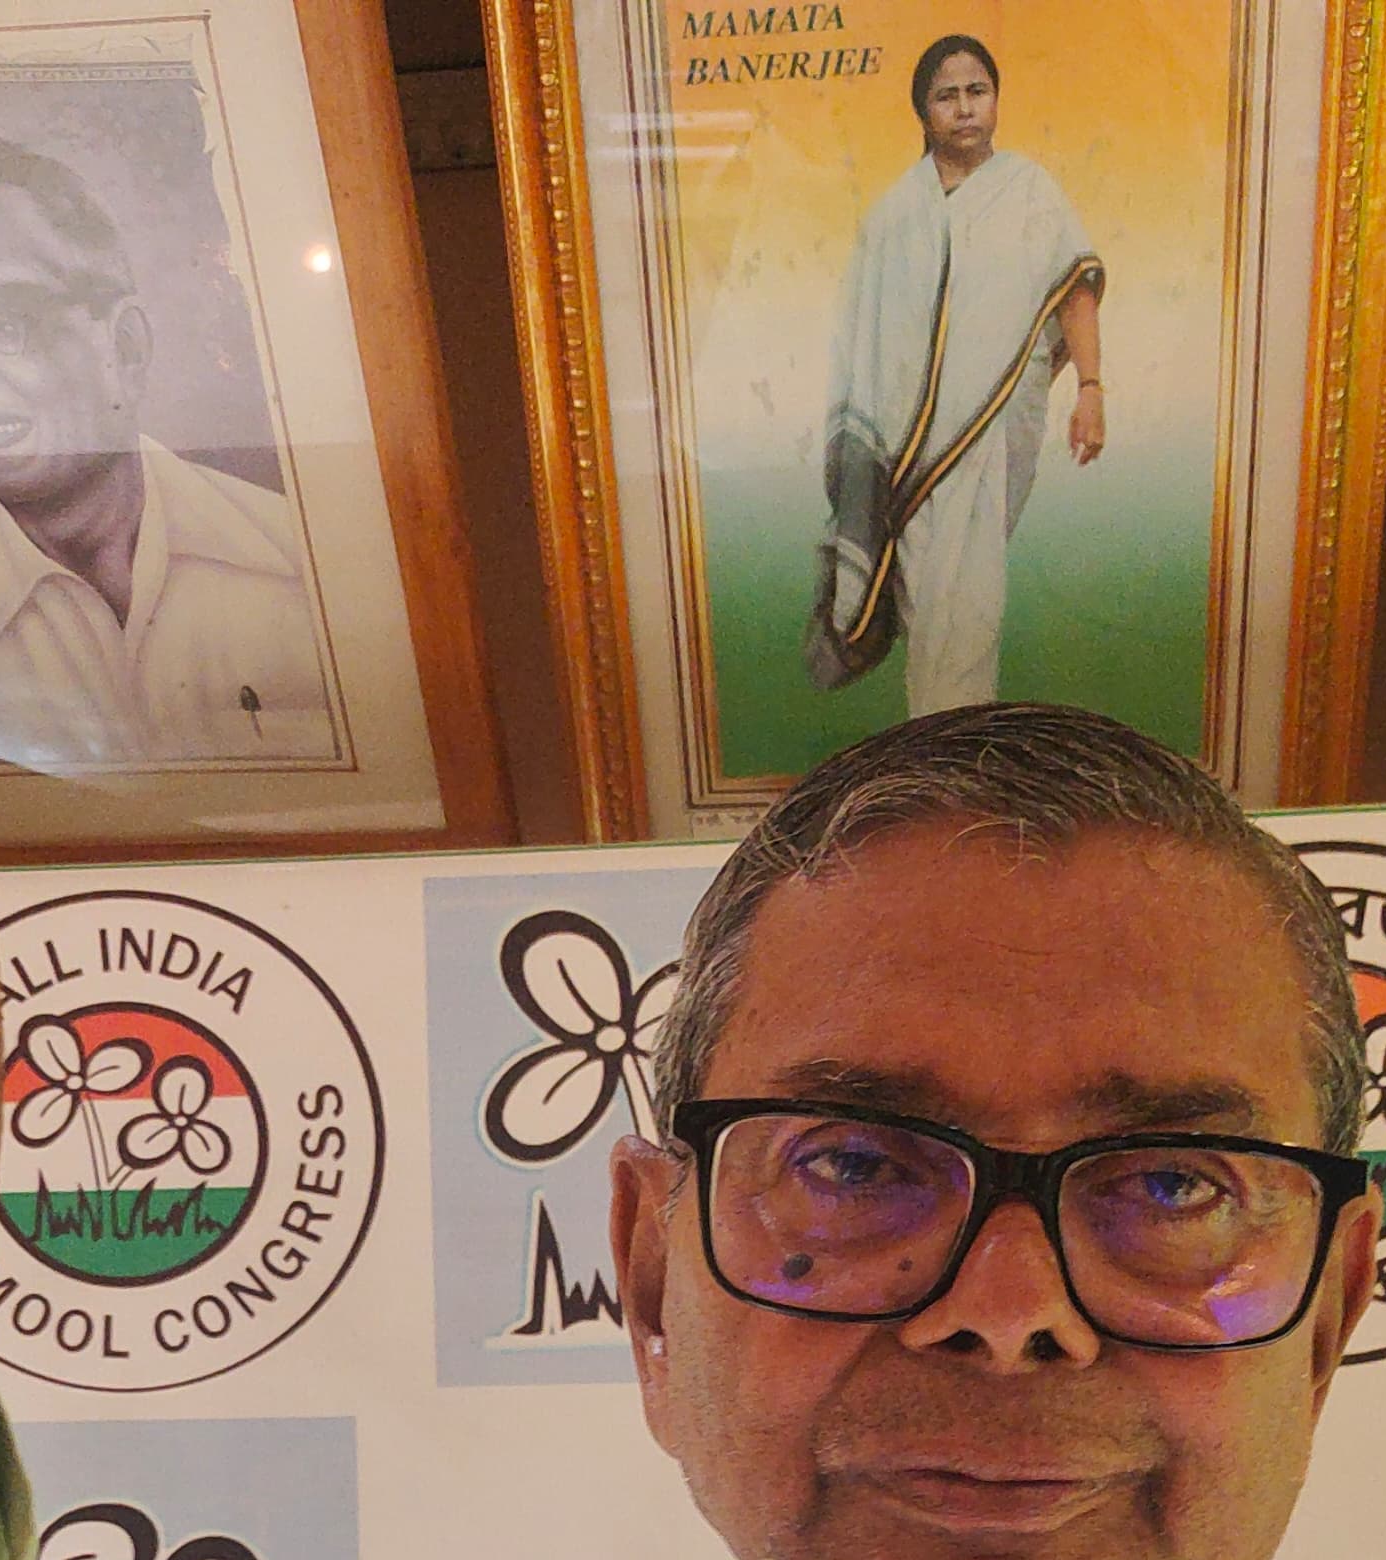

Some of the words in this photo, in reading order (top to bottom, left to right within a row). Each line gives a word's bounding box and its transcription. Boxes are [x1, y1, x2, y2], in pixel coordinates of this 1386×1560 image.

[682, 3, 845, 40] MAMATA
[685, 46, 884, 86] BANERJEE
[98, 927, 255, 1015] INDIA
[153, 1083, 346, 1354] CONGRESS
